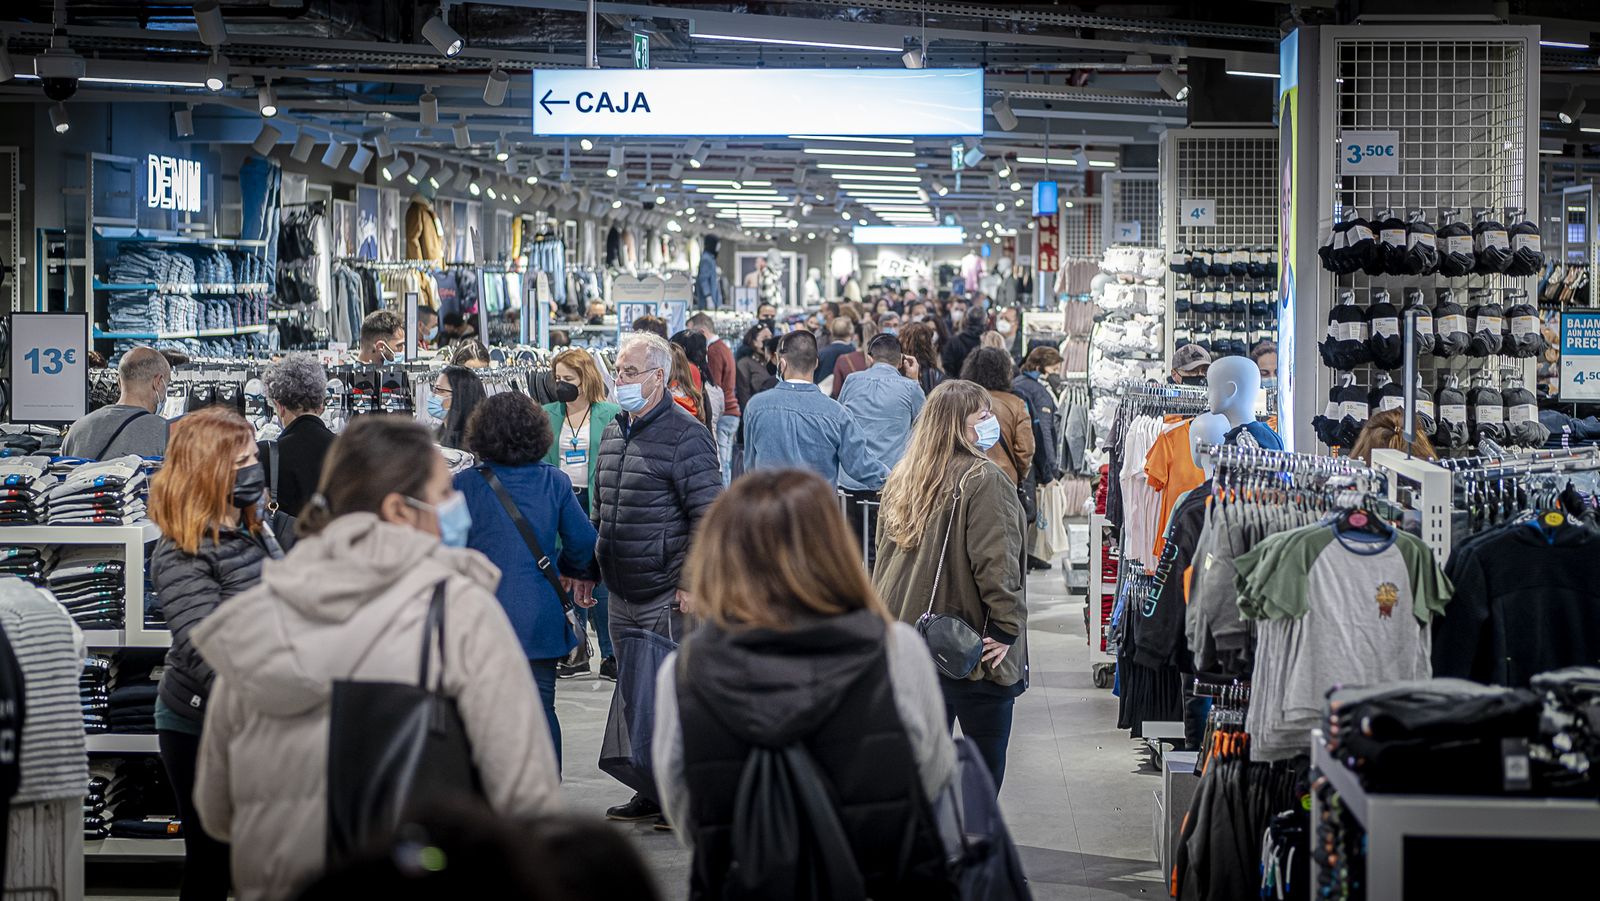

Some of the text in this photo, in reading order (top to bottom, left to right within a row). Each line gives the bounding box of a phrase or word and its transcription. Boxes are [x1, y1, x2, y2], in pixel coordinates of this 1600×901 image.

[576, 91, 651, 113] CAJA
[1347, 144, 1394, 164] 3.50€
[147, 153, 201, 212] DENIM
[1190, 207, 1206, 219] 4€
[1567, 328, 1582, 337] AÚN
[24, 348, 76, 375] 13€
